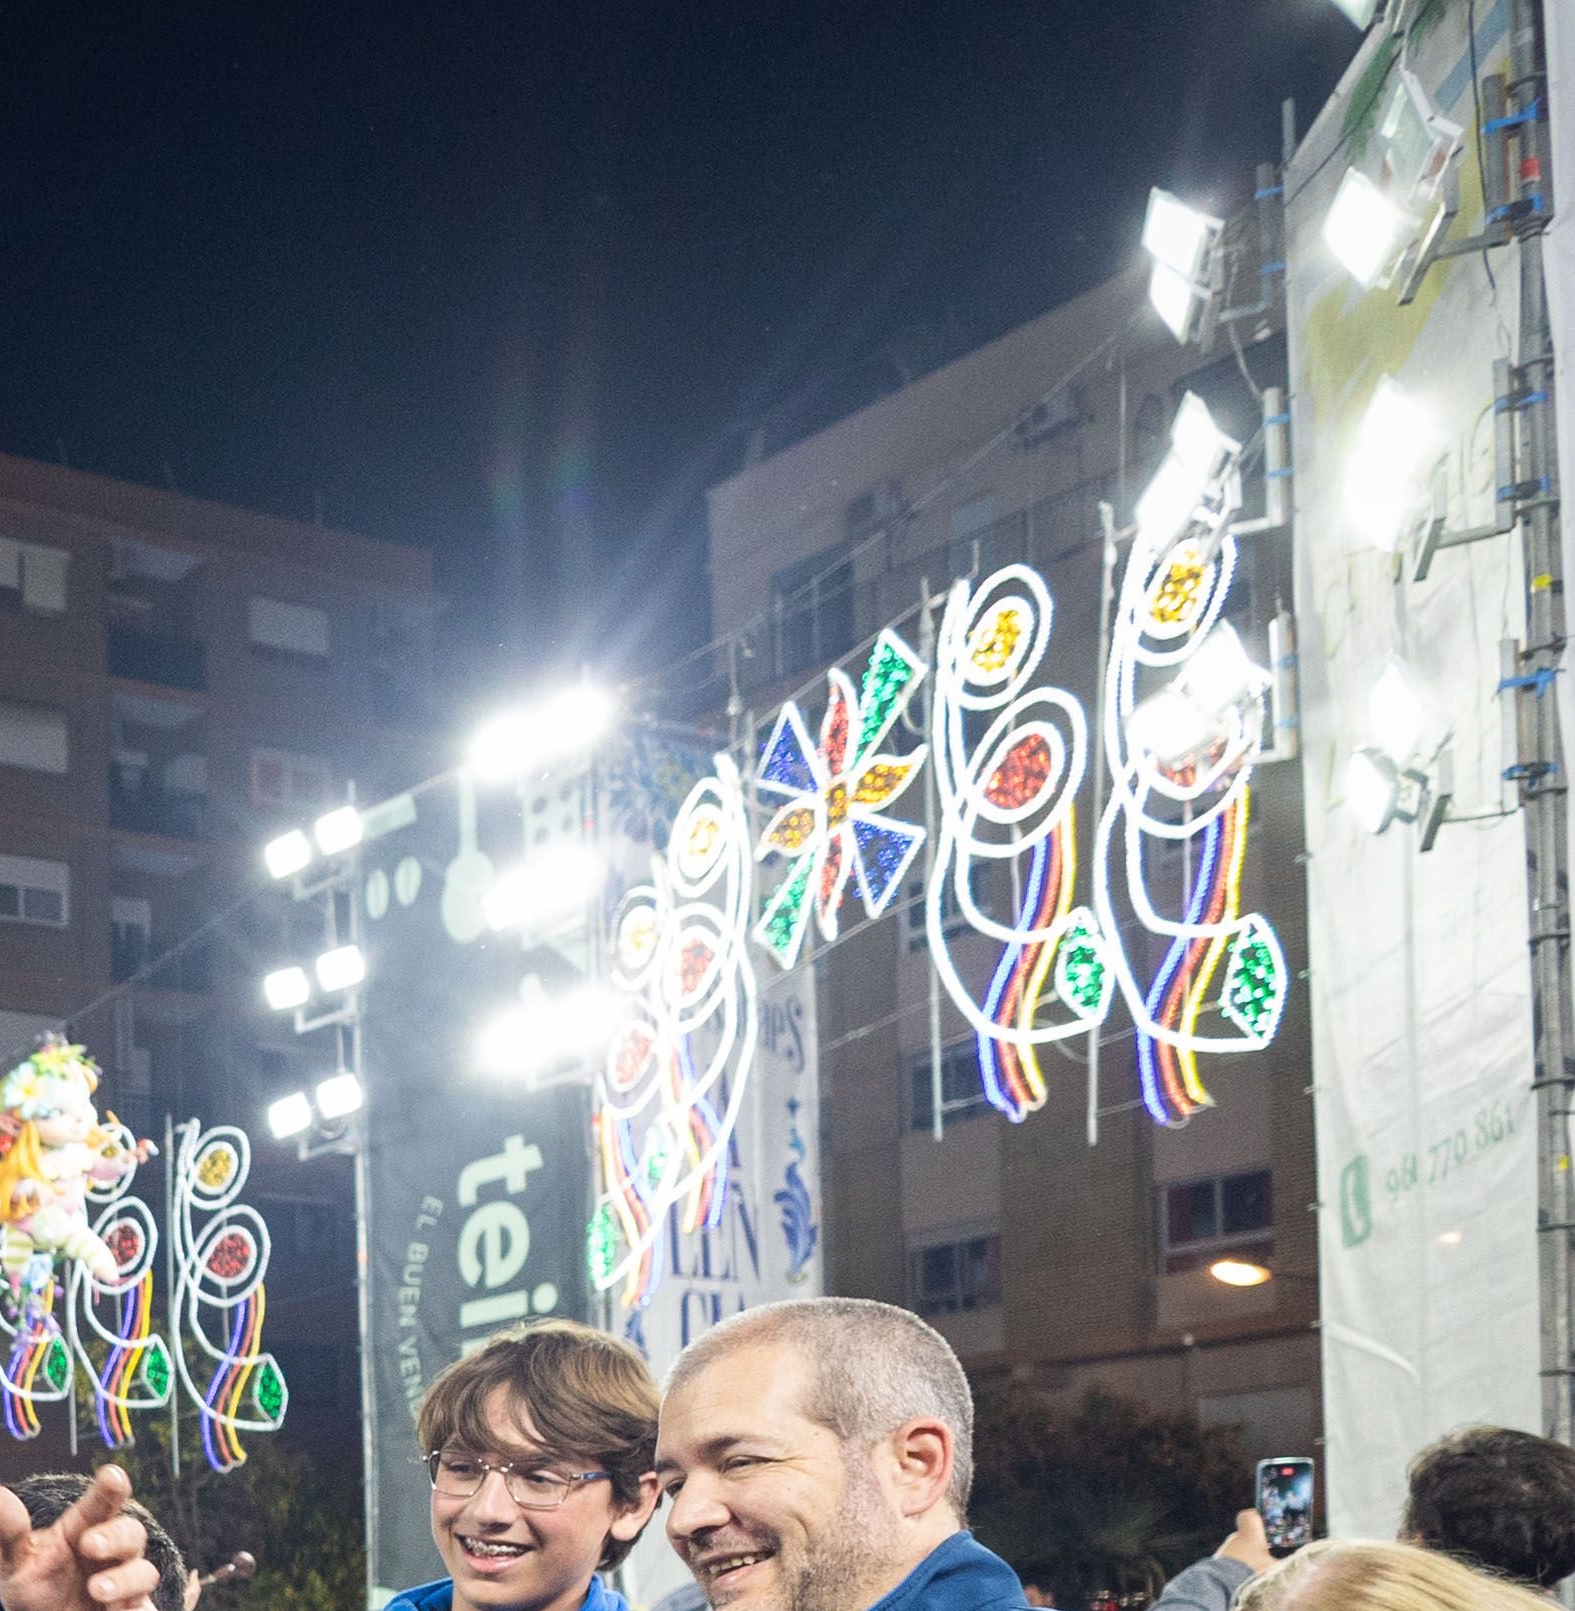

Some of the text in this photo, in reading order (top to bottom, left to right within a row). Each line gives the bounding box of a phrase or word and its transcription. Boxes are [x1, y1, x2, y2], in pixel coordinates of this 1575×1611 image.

[1428, 1129, 1468, 1186] 770
[415, 1195, 444, 1231] EL
[457, 1133, 558, 1362] tei
[399, 1241, 430, 1328] BUEN
